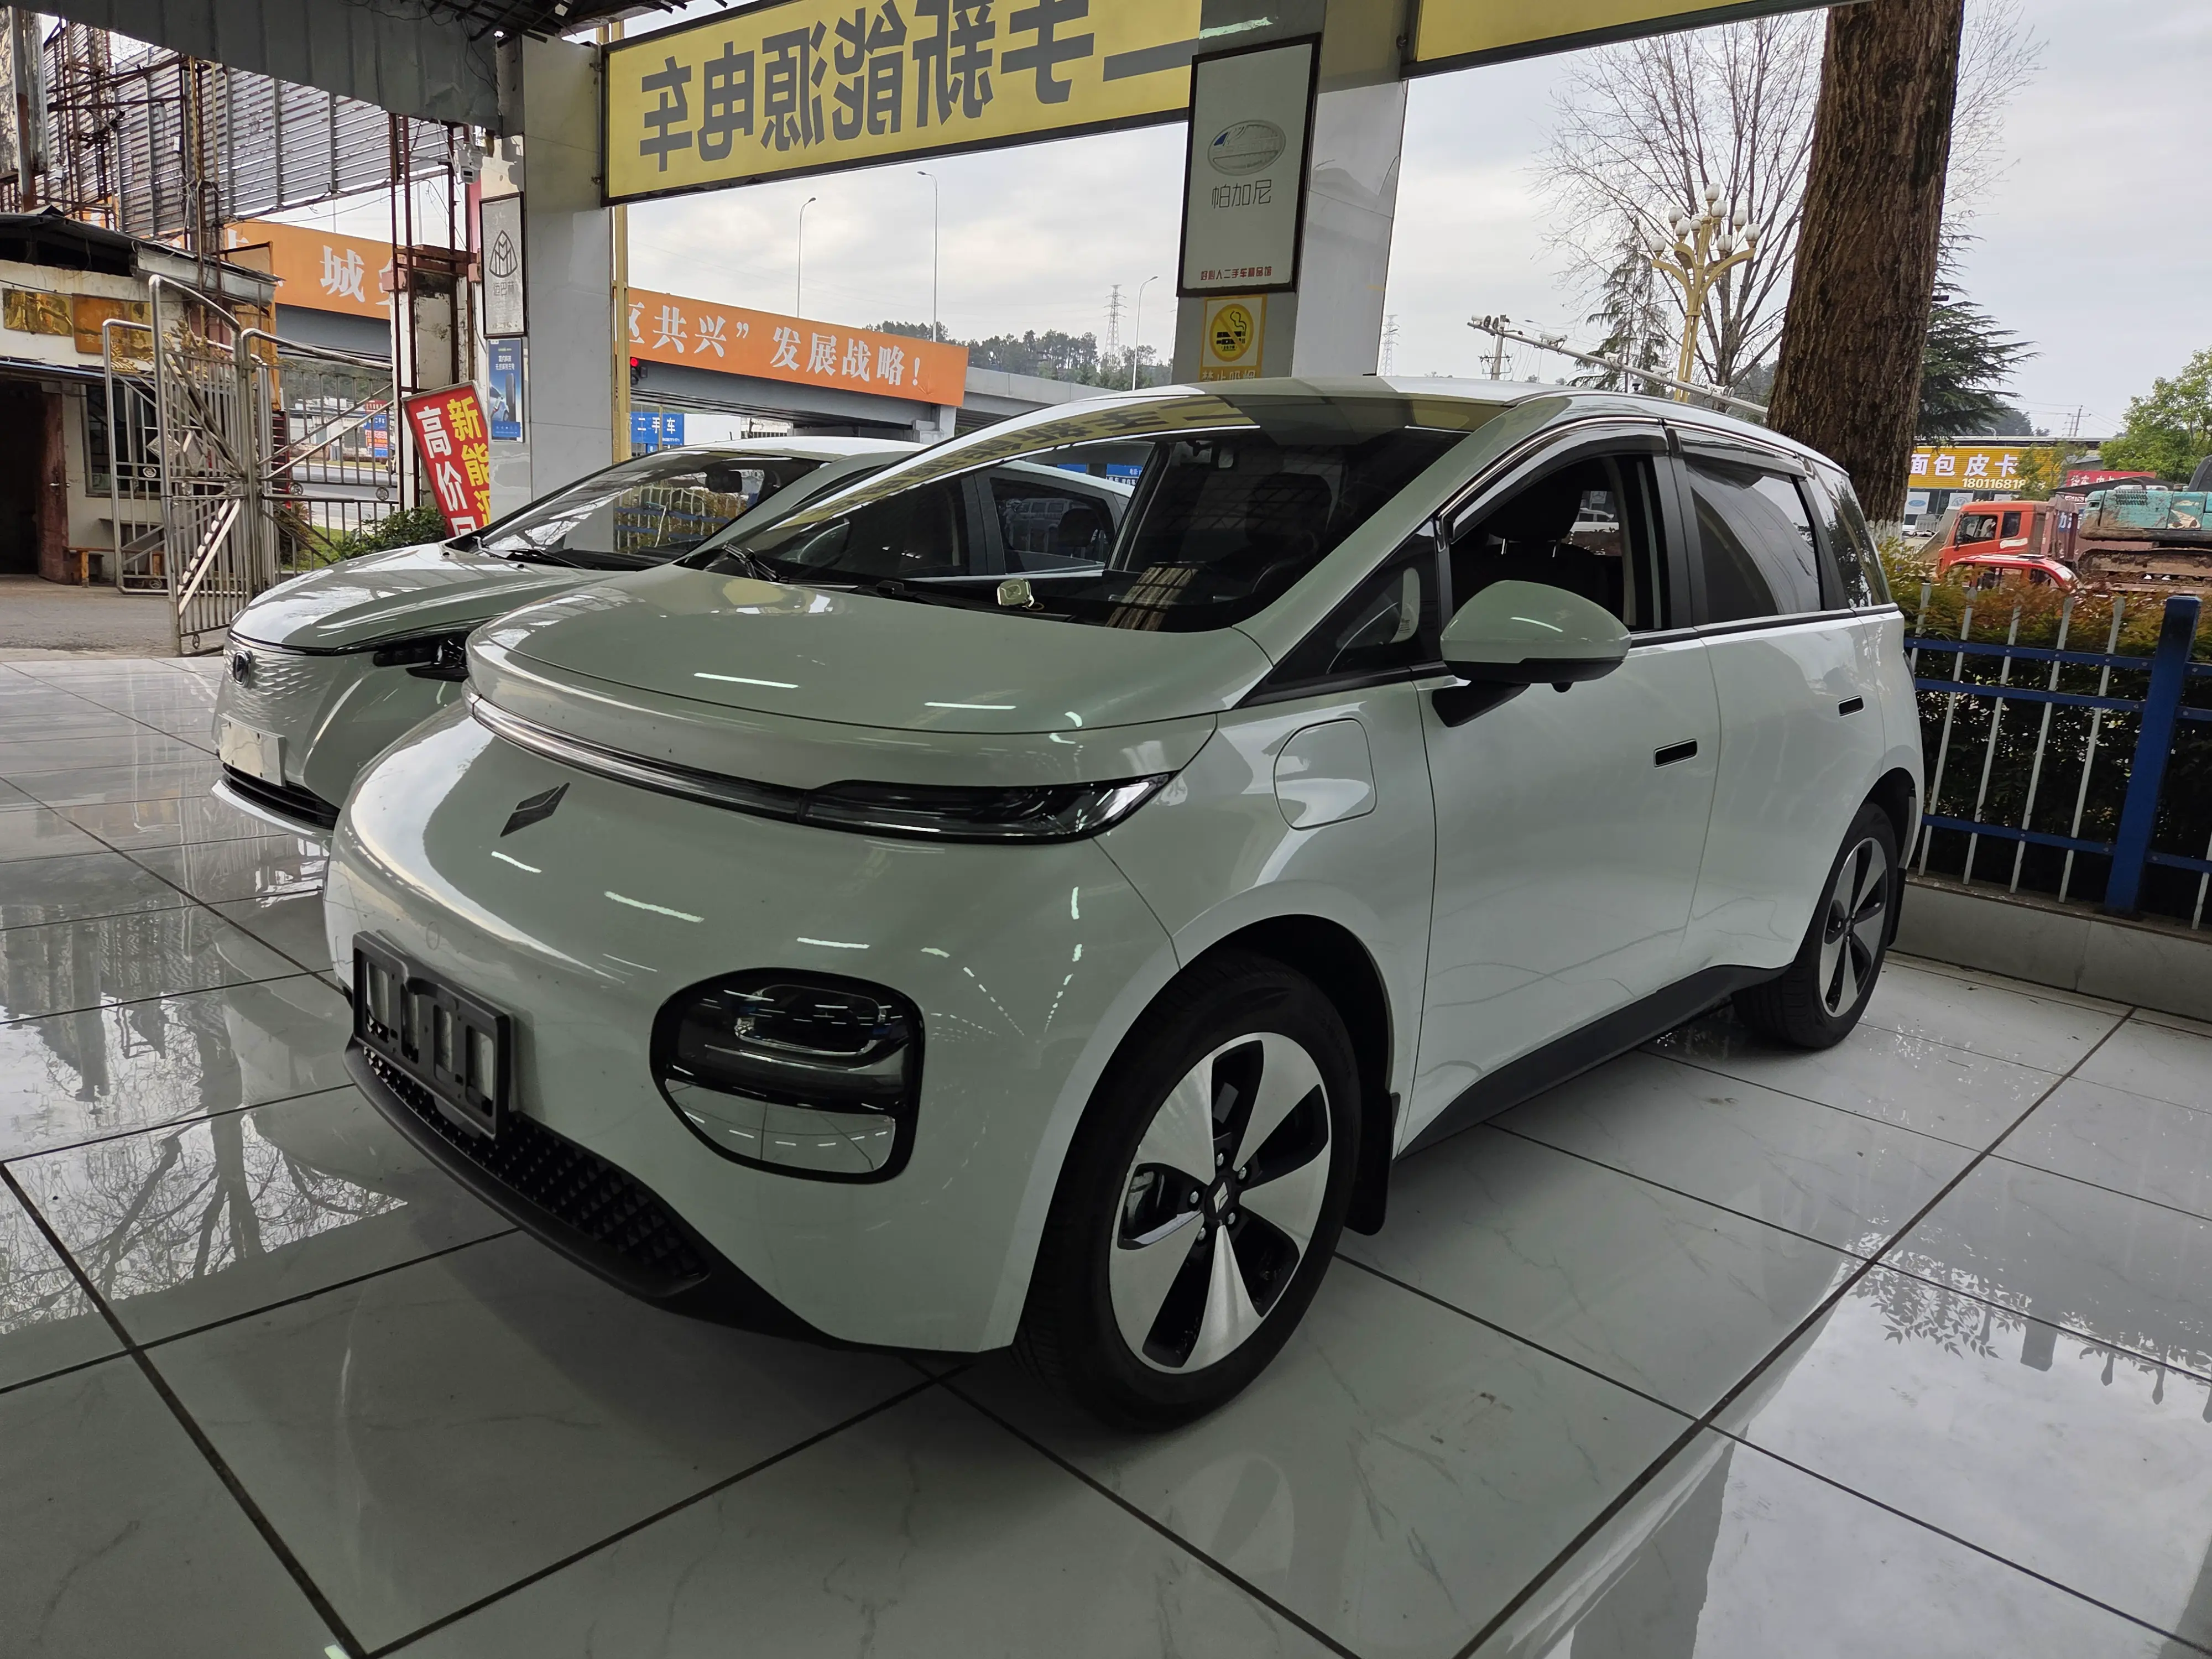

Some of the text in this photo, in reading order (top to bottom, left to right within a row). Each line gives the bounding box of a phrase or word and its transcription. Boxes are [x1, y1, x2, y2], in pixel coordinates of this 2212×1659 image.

[1211, 179, 1272, 209] 帕加尼
[1201, 265, 1272, 280] 好心人二手车精品馆
[630, 417, 676, 434] 二手车
[1911, 453, 2018, 477] 面包皮卡
